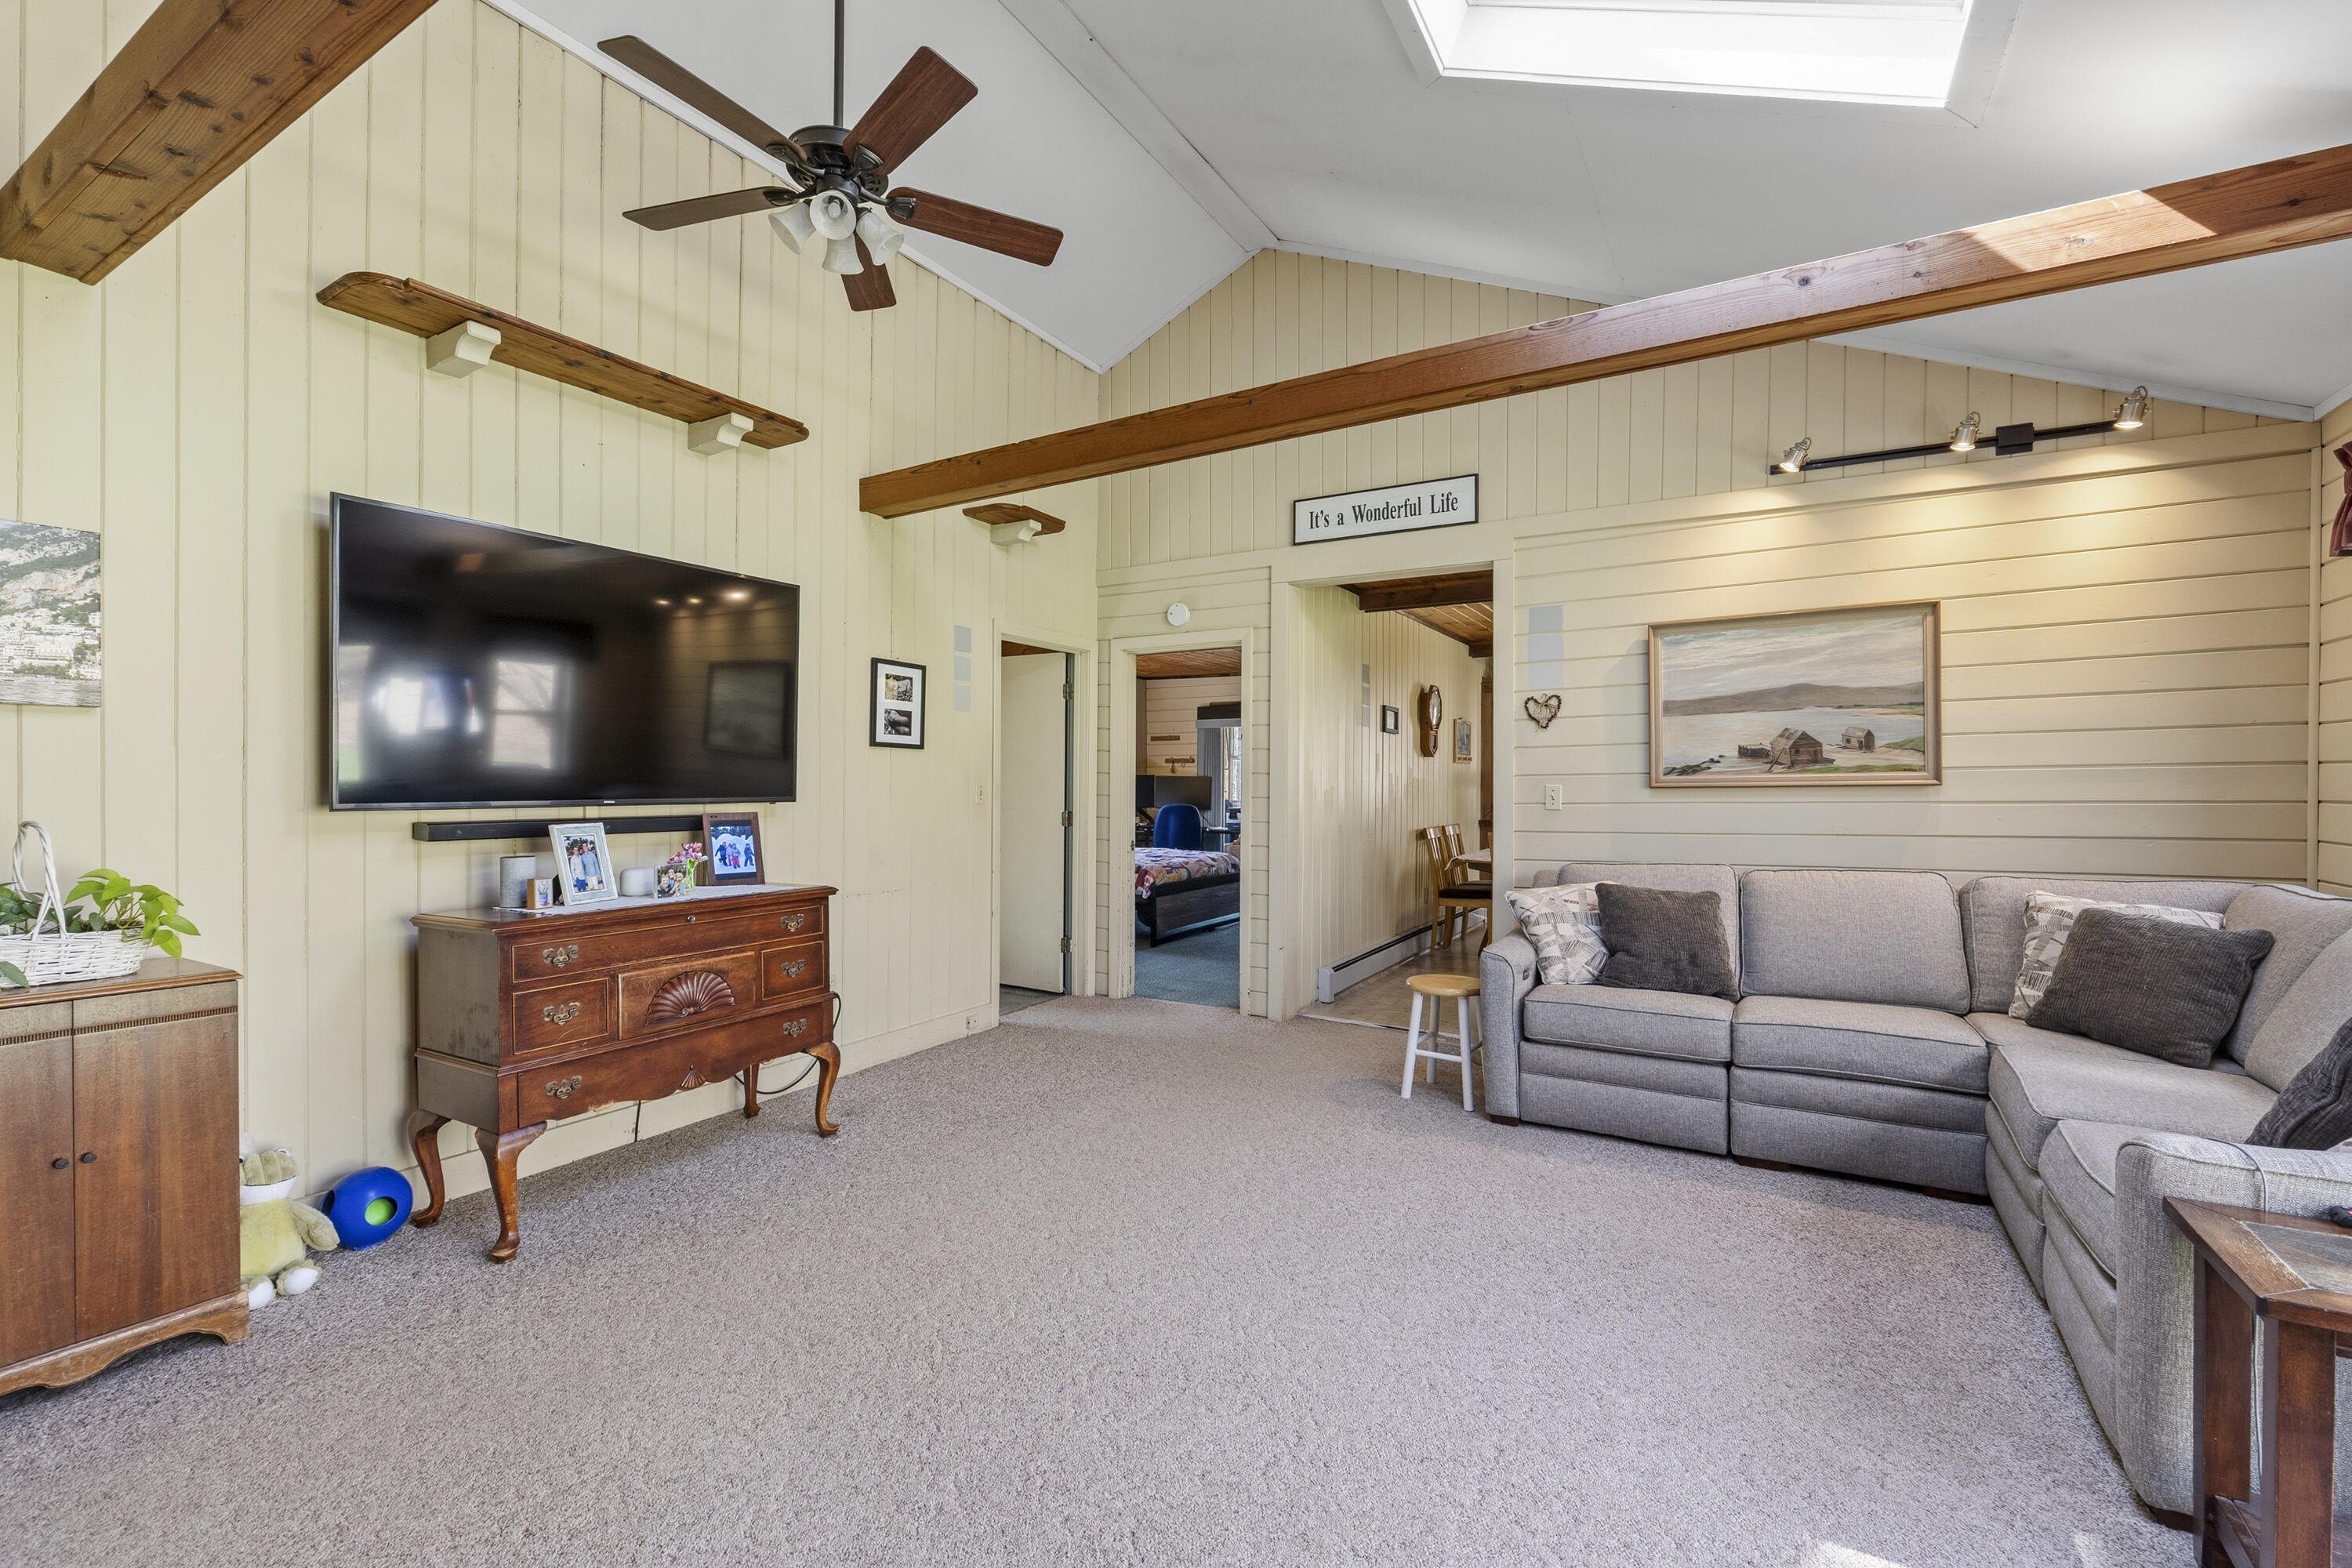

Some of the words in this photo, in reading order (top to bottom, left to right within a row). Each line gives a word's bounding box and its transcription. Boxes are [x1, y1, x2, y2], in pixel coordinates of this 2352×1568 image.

[1309, 510, 1330, 529] It's
[1338, 512, 1345, 526] a
[1352, 497, 1421, 524] Wonderful
[1430, 492, 1458, 514] Life
